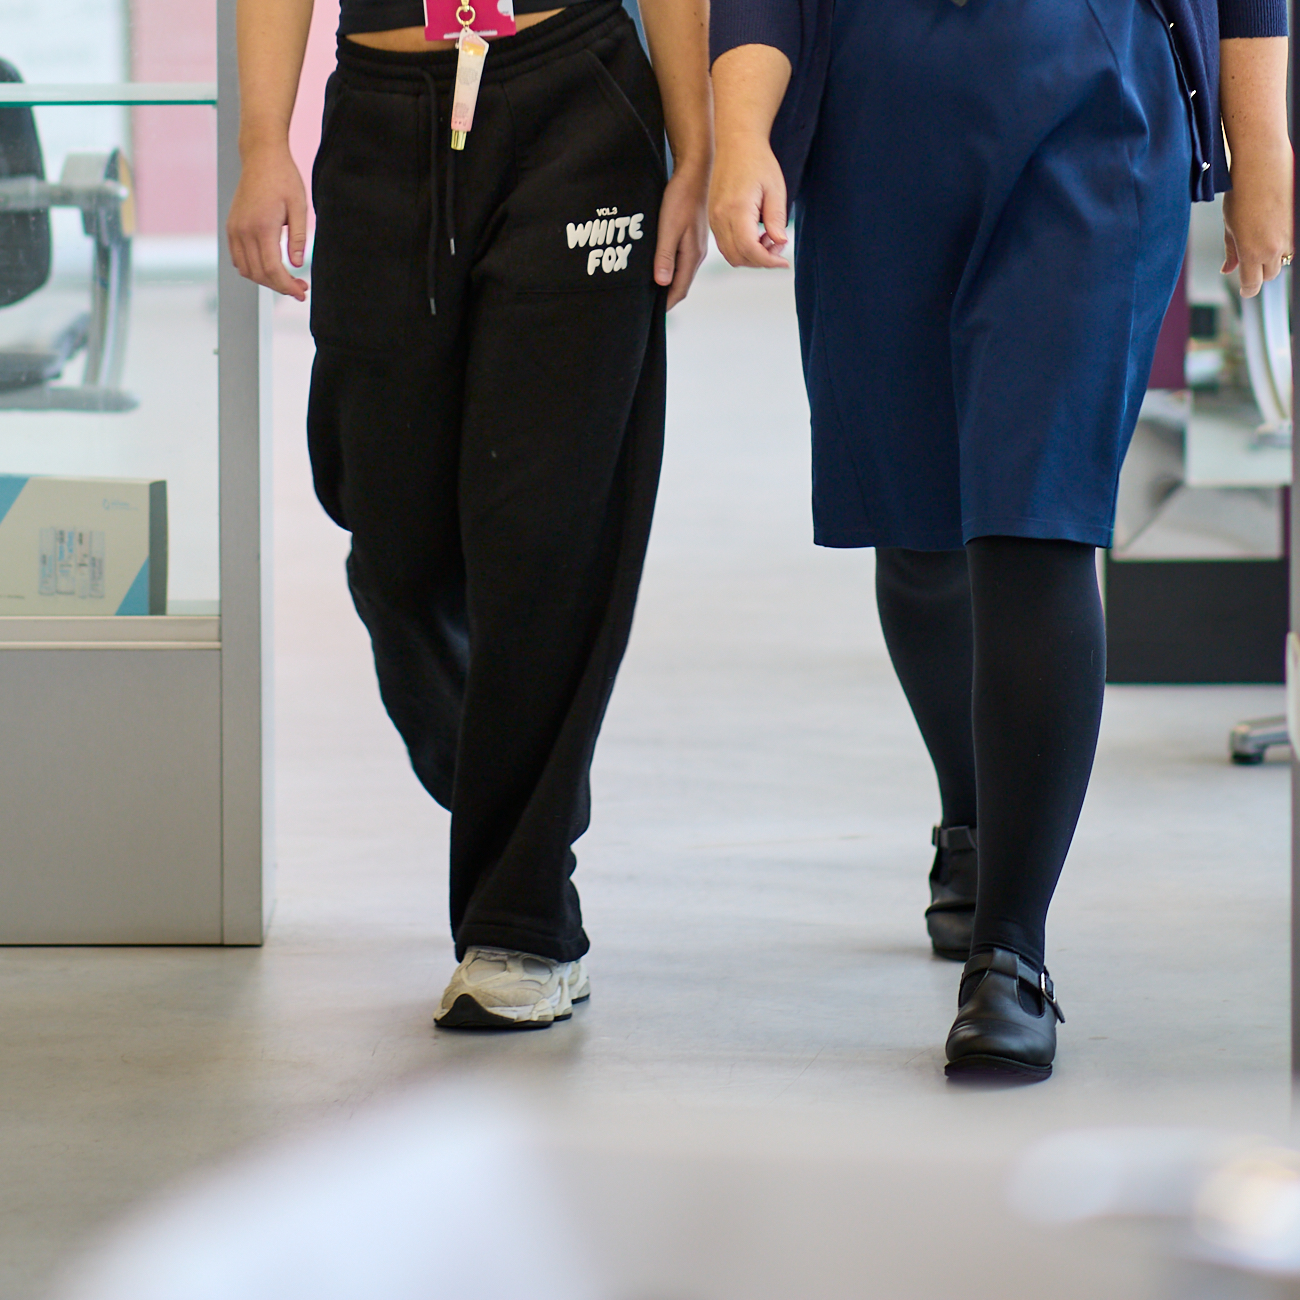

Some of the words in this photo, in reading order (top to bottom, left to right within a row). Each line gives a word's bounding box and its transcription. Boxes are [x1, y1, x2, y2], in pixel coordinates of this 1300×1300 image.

[596, 207, 618, 217] VOL.3
[566, 212, 644, 250] WHITE
[587, 243, 633, 276] FOX
